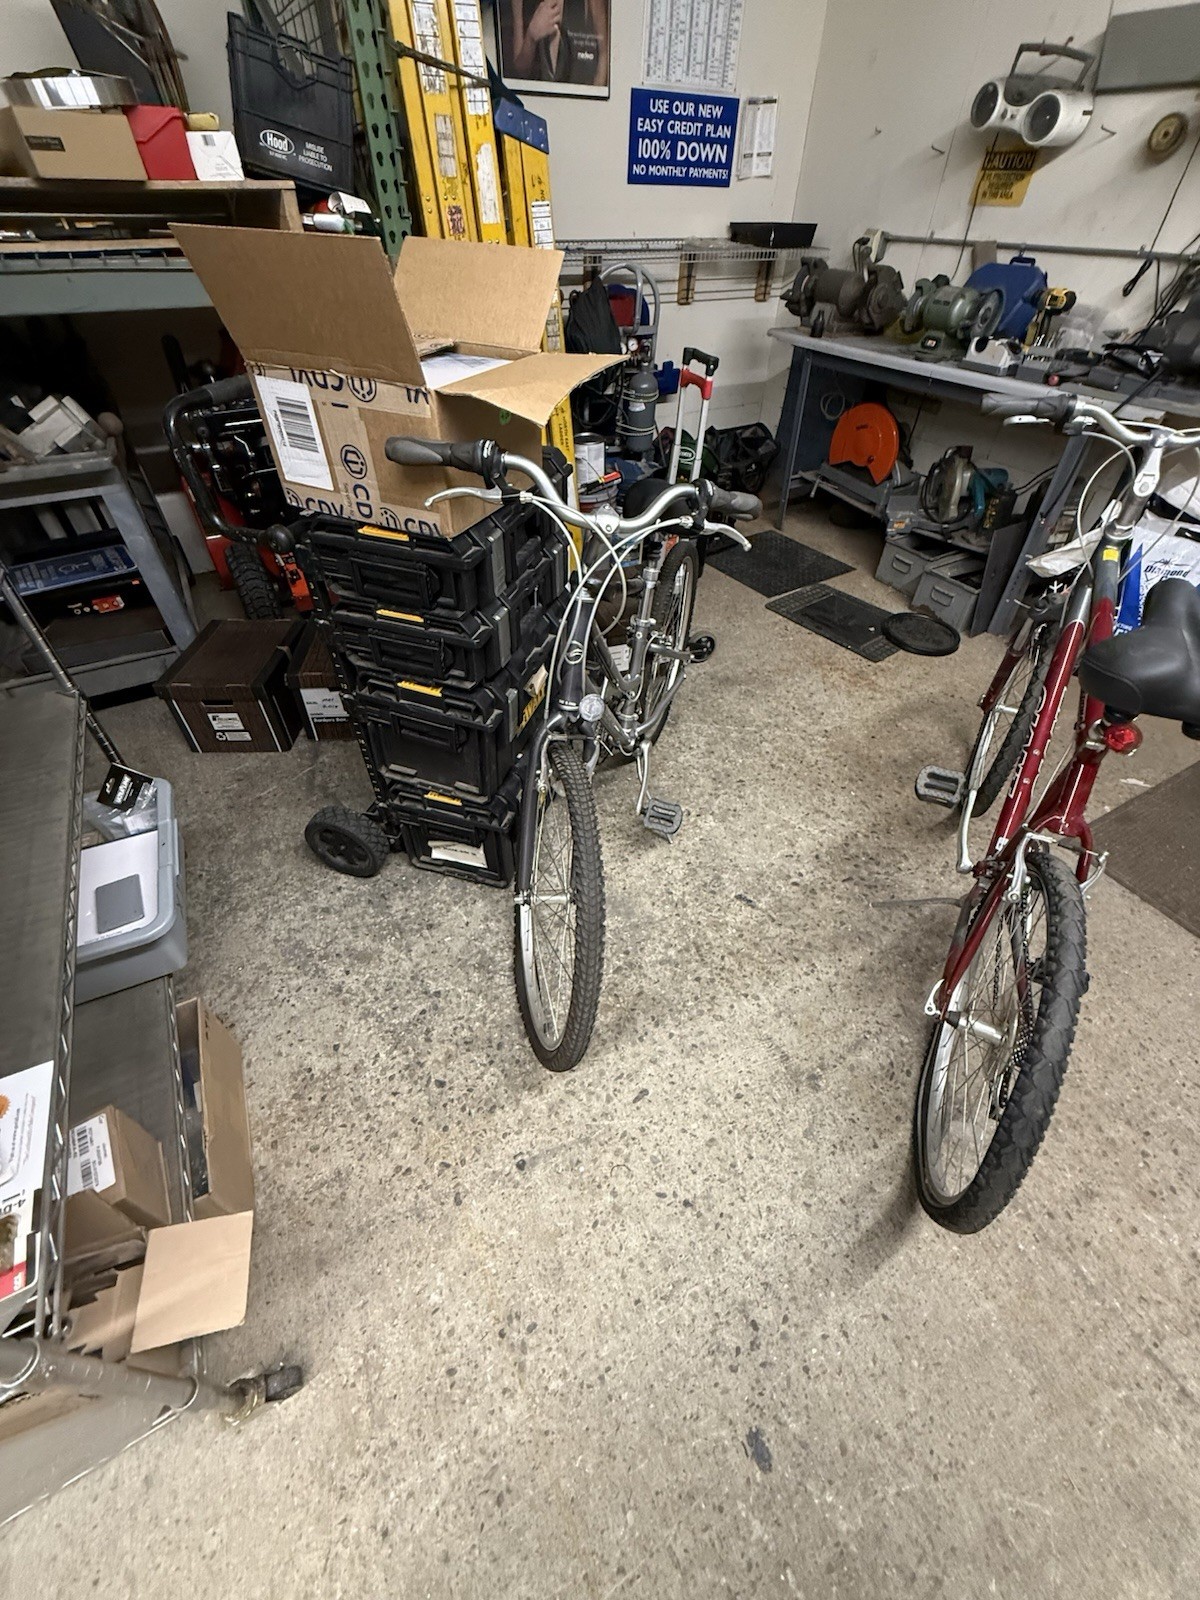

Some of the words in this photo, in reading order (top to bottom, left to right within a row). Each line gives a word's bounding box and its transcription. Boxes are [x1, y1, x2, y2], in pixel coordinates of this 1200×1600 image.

[650, 98, 669, 114] USE
[672, 101, 695, 116] OUR
[698, 103, 724, 119] NEW
[637, 117, 664, 133] EASY
[667, 120, 703, 137] CREDIT
[705, 125, 732, 139] PLAN
[266, 132, 288, 151] Hood
[303, 149, 320, 160] LIABLE
[319, 154, 328, 163] TO
[637, 138, 671, 160] 100%
[676, 141, 727, 163] DOWN
[298, 155, 333, 172] PROSECUTION
[984, 152, 1036, 169] CAUTION
[633, 164, 646, 175] NO
[648, 165, 687, 177] MONTHLY
[688, 166, 729, 180] PAYMENTS!
[1144, 565, 1191, 578] Diamond
